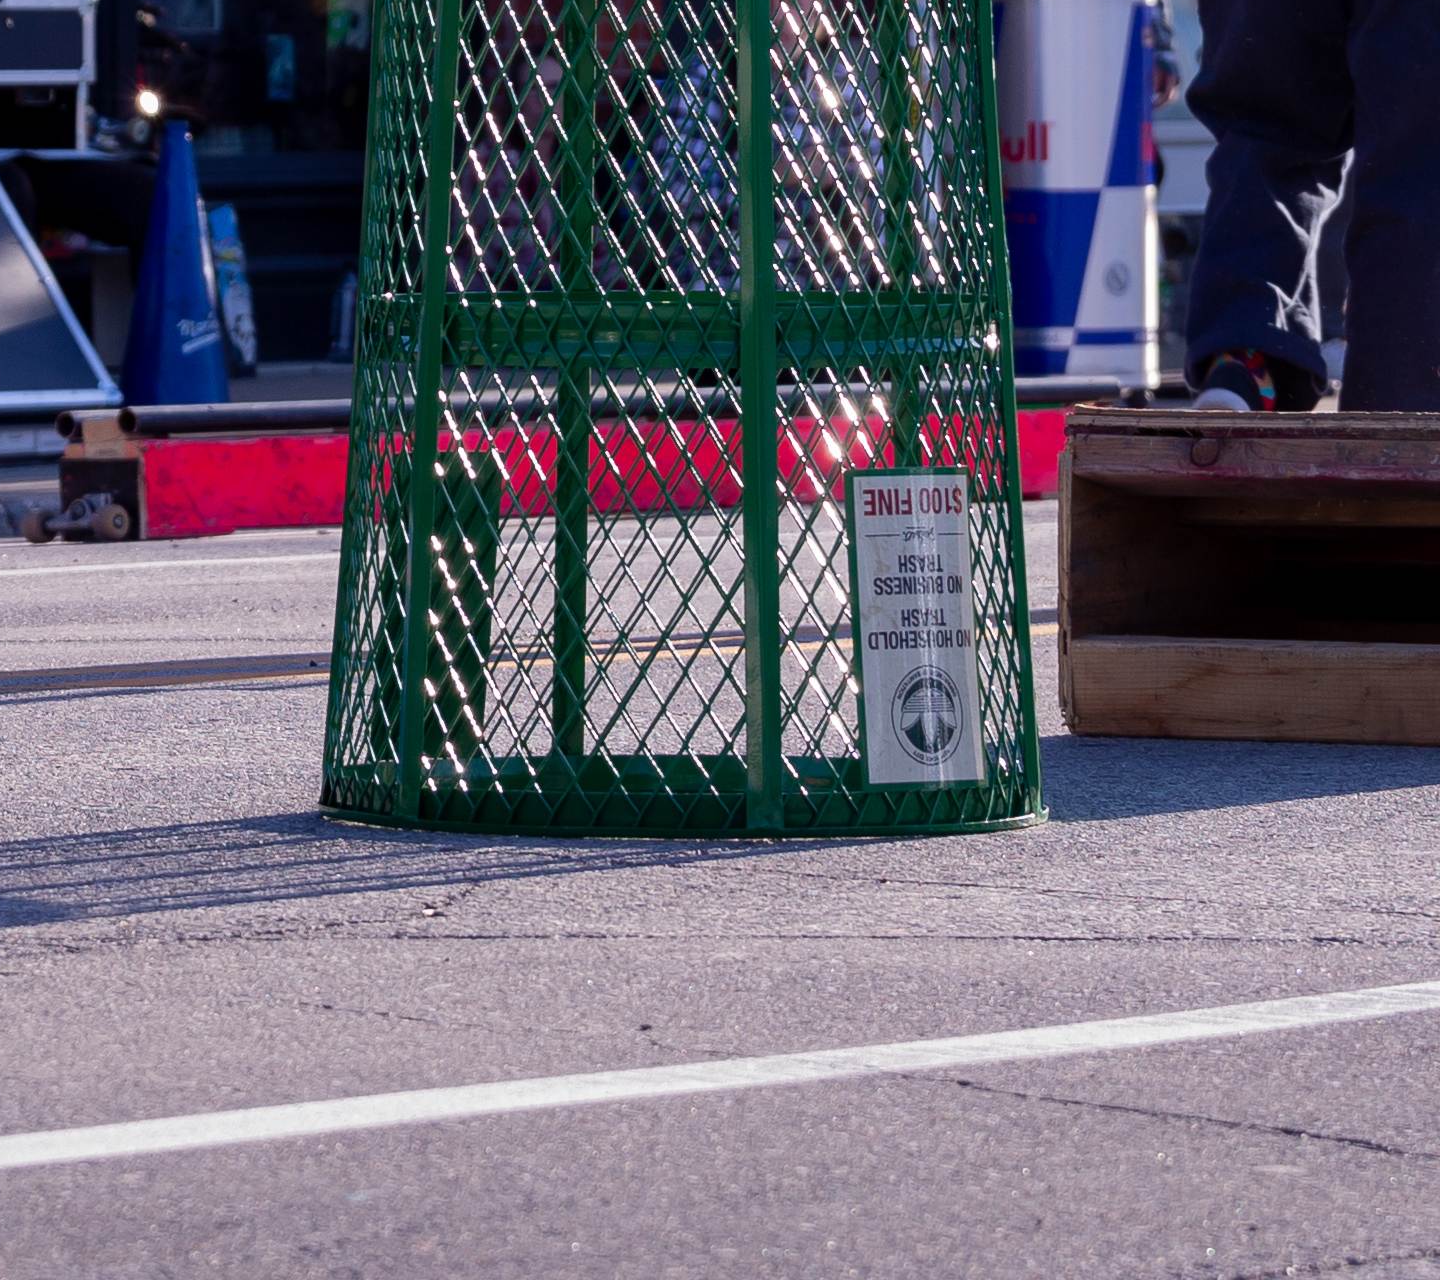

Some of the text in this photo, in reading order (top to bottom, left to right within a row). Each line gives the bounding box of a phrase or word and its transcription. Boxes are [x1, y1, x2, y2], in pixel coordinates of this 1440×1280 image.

[863, 485, 963, 517] $100 FINE
[897, 553, 944, 573] TRASH
[873, 575, 963, 596] NO BUSINESS
[900, 607, 947, 627] TRASH
[868, 629, 971, 651] NO HOUSEHOLD
